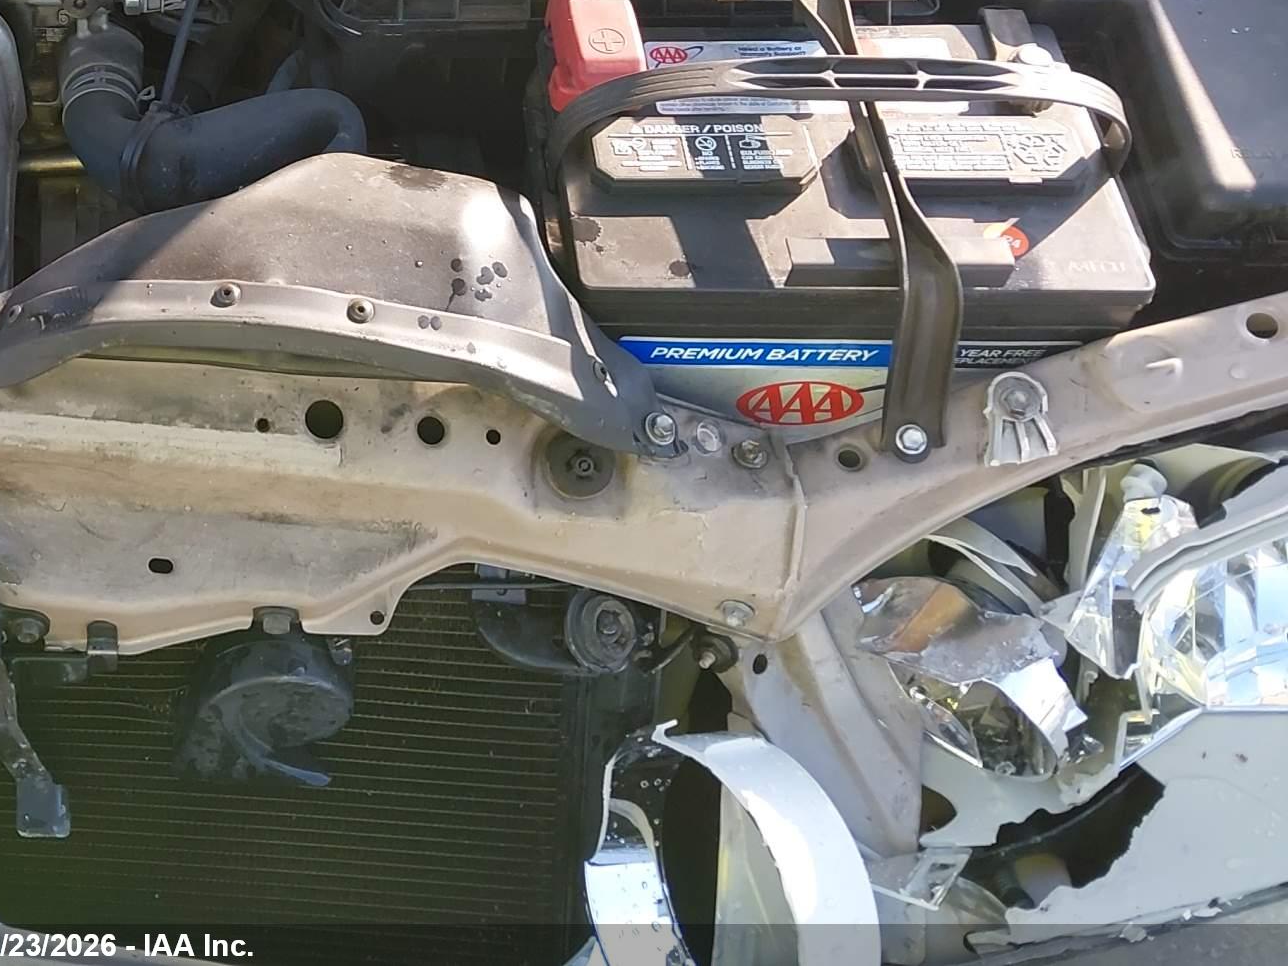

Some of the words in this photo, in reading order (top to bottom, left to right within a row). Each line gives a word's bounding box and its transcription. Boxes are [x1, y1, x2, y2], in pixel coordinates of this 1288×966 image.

[650, 47, 688, 64] AAA
[650, 347, 763, 360] PREMIUM
[766, 349, 879, 362] BATTERY
[960, 349, 1001, 357] YEAR
[1003, 349, 1046, 357] FREE
[745, 382, 855, 424] AAA
